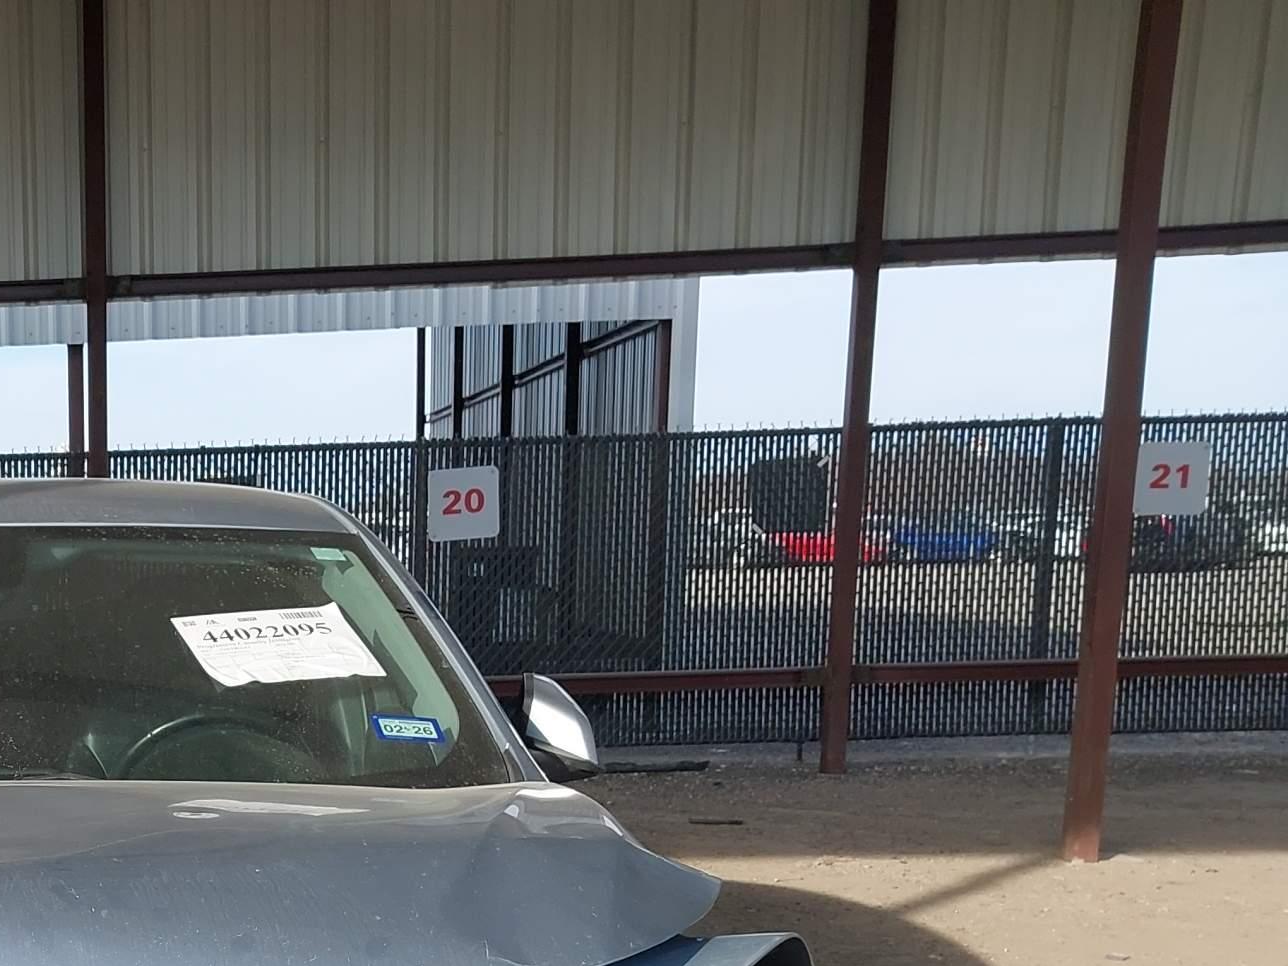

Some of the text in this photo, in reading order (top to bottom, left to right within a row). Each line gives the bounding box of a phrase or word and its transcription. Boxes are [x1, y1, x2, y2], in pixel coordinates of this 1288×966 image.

[1149, 463, 1190, 489] 21
[442, 488, 485, 516] 20
[202, 622, 333, 644] 44022095
